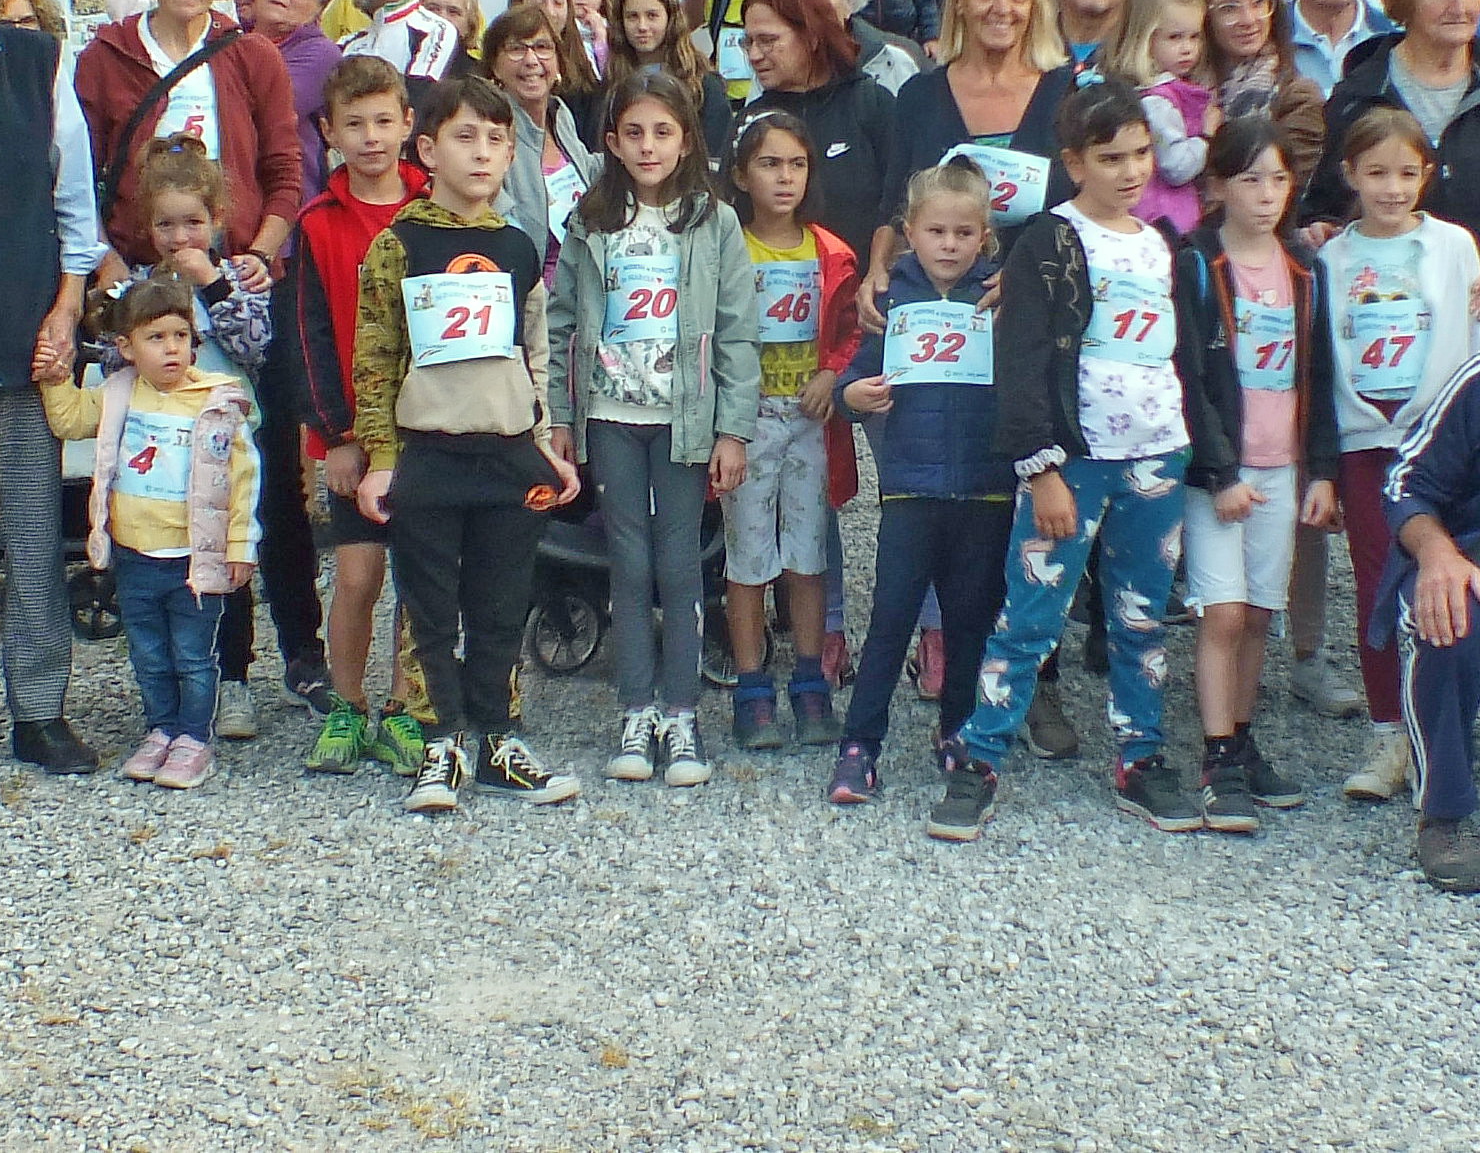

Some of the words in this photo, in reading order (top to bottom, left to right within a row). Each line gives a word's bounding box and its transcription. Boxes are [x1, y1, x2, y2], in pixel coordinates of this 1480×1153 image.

[623, 287, 678, 321] 20
[766, 291, 811, 323] 46
[440, 305, 492, 340] 21
[1113, 308, 1160, 342] 17
[909, 332, 966, 363] 32
[1361, 335, 1416, 369] 47
[127, 445, 157, 475] 4
